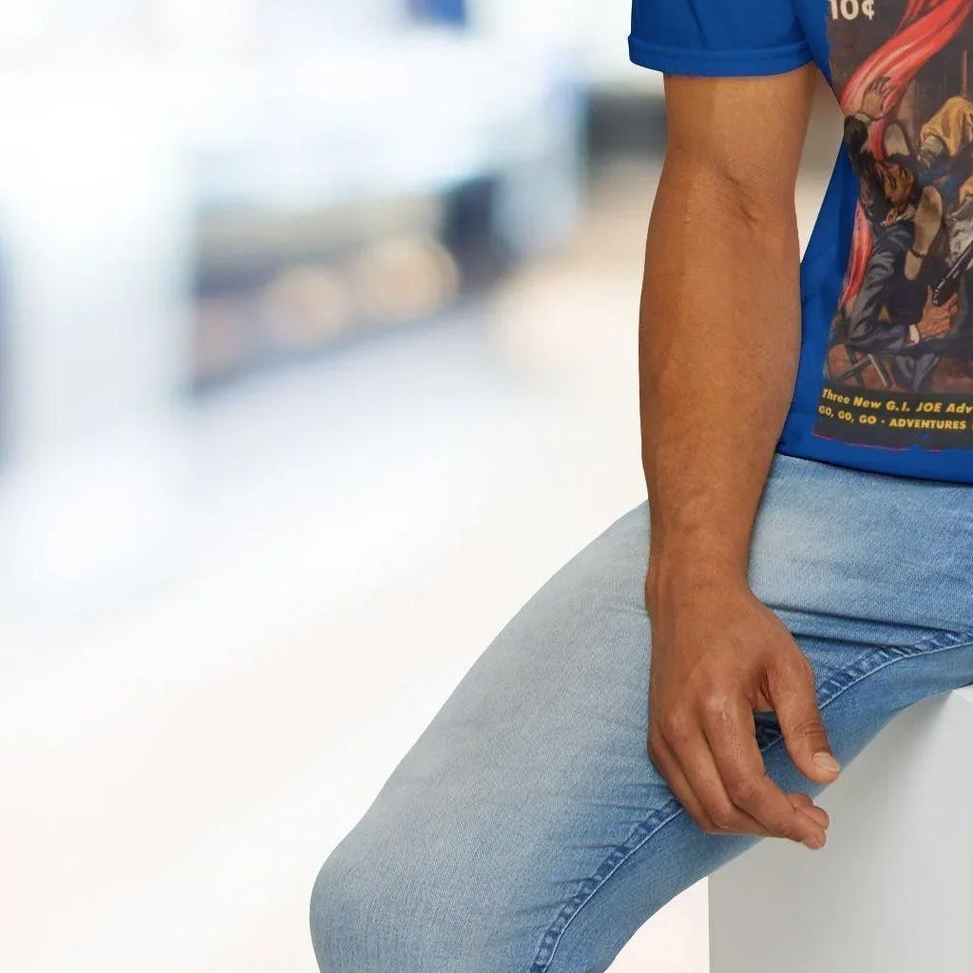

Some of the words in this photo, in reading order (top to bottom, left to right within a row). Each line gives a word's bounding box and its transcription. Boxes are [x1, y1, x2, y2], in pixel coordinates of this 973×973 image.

[822, 388, 850, 404] Three
[853, 396, 881, 409] New
[916, 402, 942, 413] JOE
[818, 405, 834, 418] GO,
[838, 410, 854, 423] GO,
[859, 414, 877, 424] GO
[889, 418, 967, 430] ADVENTURES
